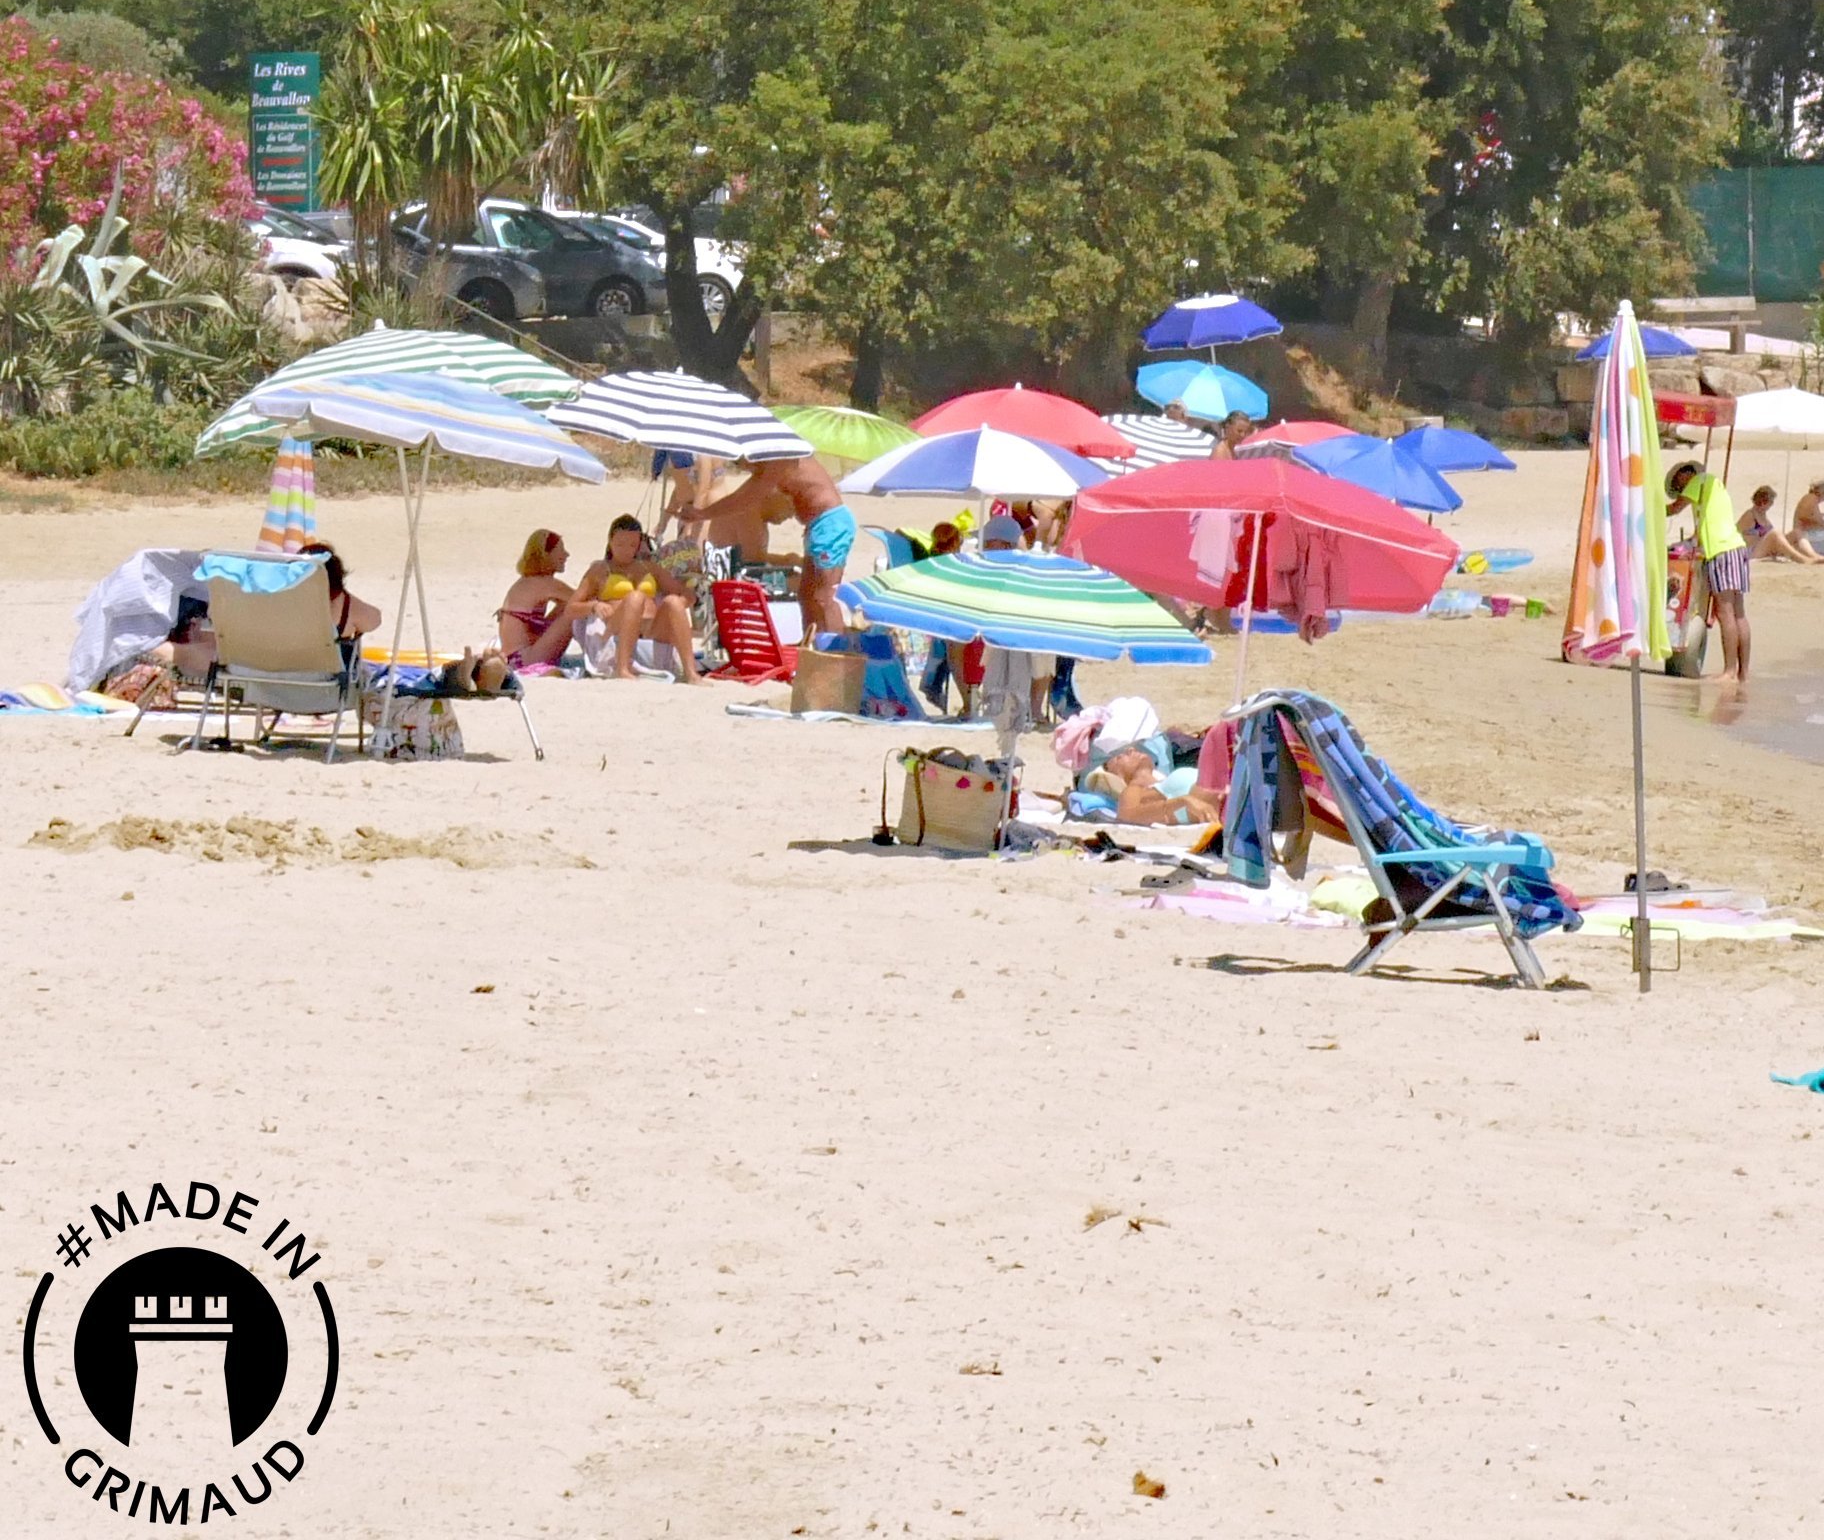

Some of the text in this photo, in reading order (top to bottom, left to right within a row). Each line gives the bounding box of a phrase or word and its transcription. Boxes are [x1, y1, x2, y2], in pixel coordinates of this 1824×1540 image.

[254, 61, 307, 77] Les Rives
[271, 79, 285, 92] de
[251, 91, 311, 108] Beauvallon
